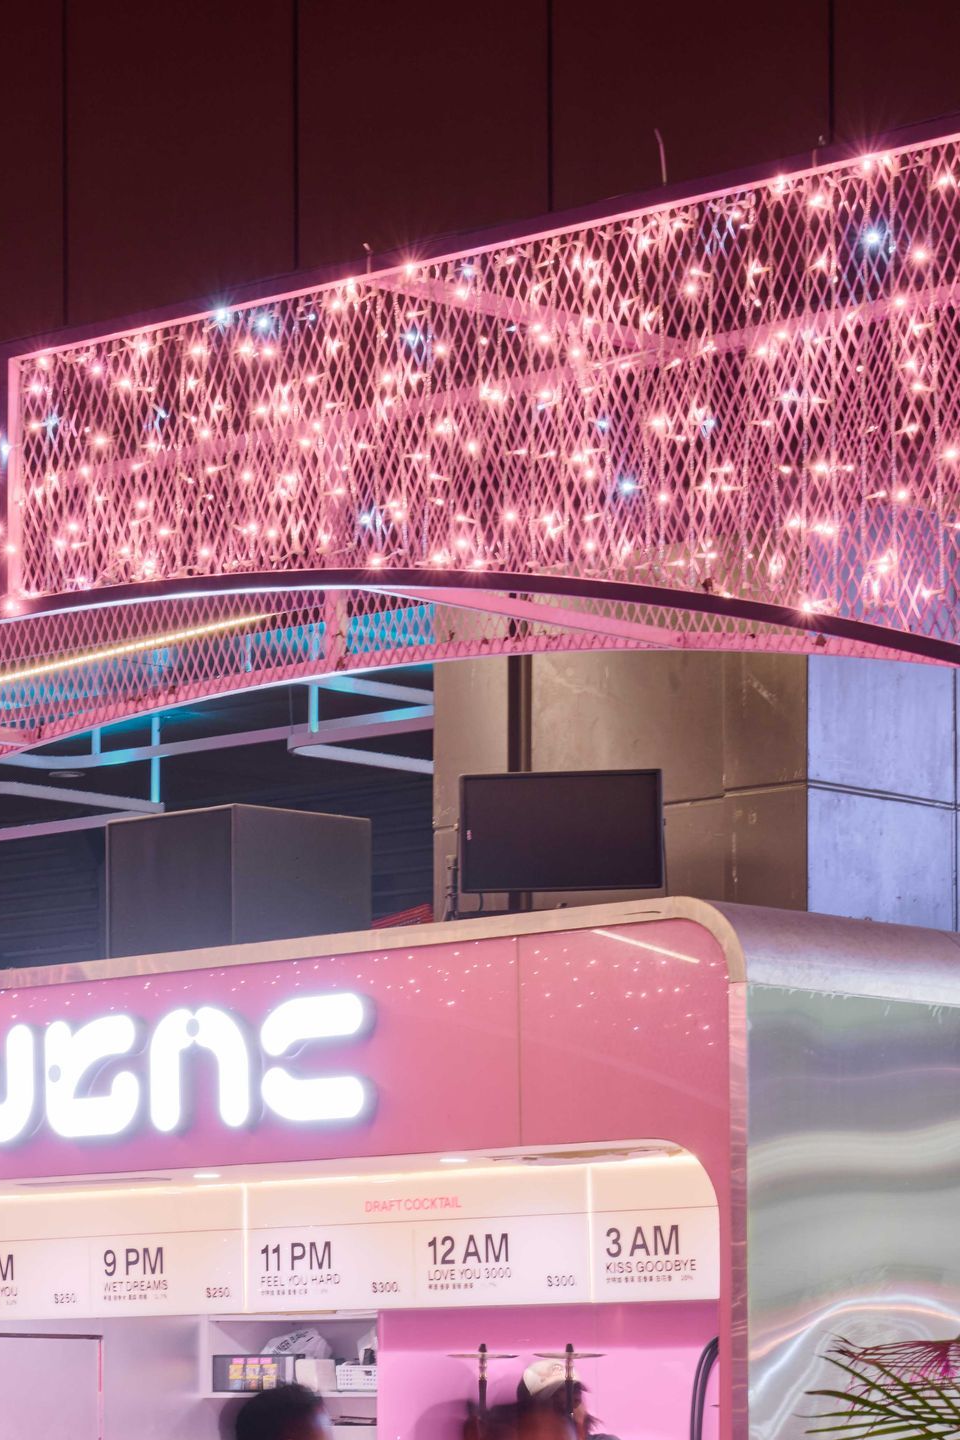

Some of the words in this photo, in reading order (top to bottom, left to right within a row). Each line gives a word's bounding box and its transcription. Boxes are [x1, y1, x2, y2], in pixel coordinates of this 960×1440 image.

[365, 1199, 401, 1213] DRAFT
[406, 1196, 462, 1211] COCKTAIL
[606, 1227, 622, 1258] 3
[629, 1225, 680, 1257] AM
[261, 1244, 281, 1271] 11
[290, 1241, 332, 1270] PM
[428, 1236, 455, 1265] 12
[462, 1233, 509, 1264] AM
[103, 1249, 117, 1277] 9
[125, 1247, 164, 1276] PM
[605, 1261, 633, 1274] KISS
[636, 1259, 697, 1273] GOODBYE
[261, 1275, 286, 1287] FEEL
[288, 1274, 308, 1286] YOU
[427, 1269, 456, 1281] LOVE
[459, 1267, 481, 1280] YOU
[485, 1267, 512, 1279] 3000
[546, 1274, 576, 1287] $300
[0, 1285, 19, 1297] YOU
[126, 1279, 169, 1291] DREAMS
[206, 1286, 231, 1298] $250
[371, 1281, 399, 1293] $300
